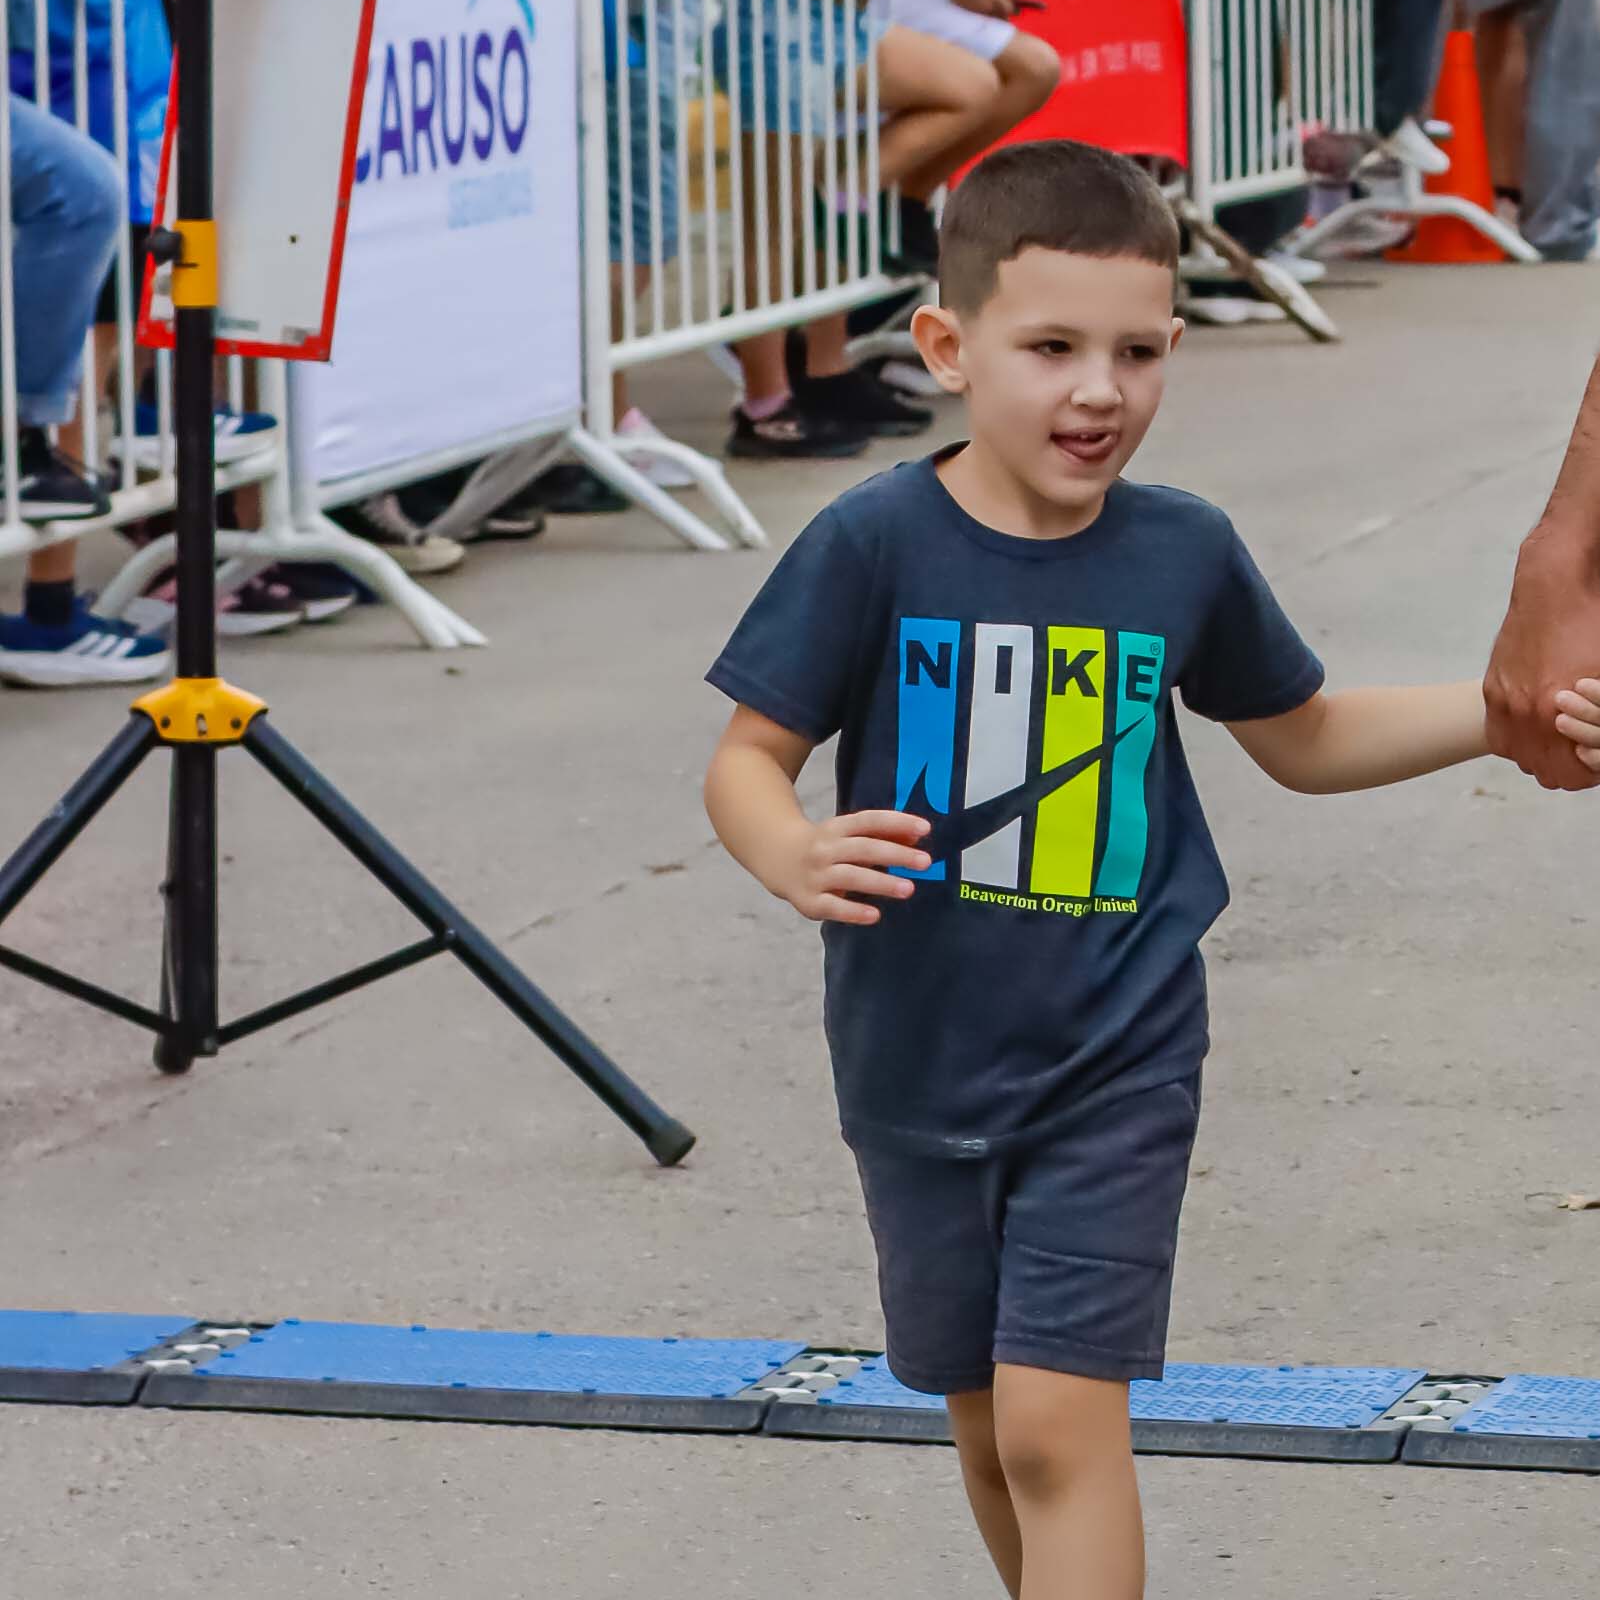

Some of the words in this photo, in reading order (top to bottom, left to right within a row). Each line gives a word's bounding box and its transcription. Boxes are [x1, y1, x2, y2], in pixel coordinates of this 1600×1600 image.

[355, 26, 529, 184] ARUSO
[905, 639, 1158, 703] NIKE
[960, 884, 1037, 910] Beaverton
[1094, 897, 1138, 913] United
